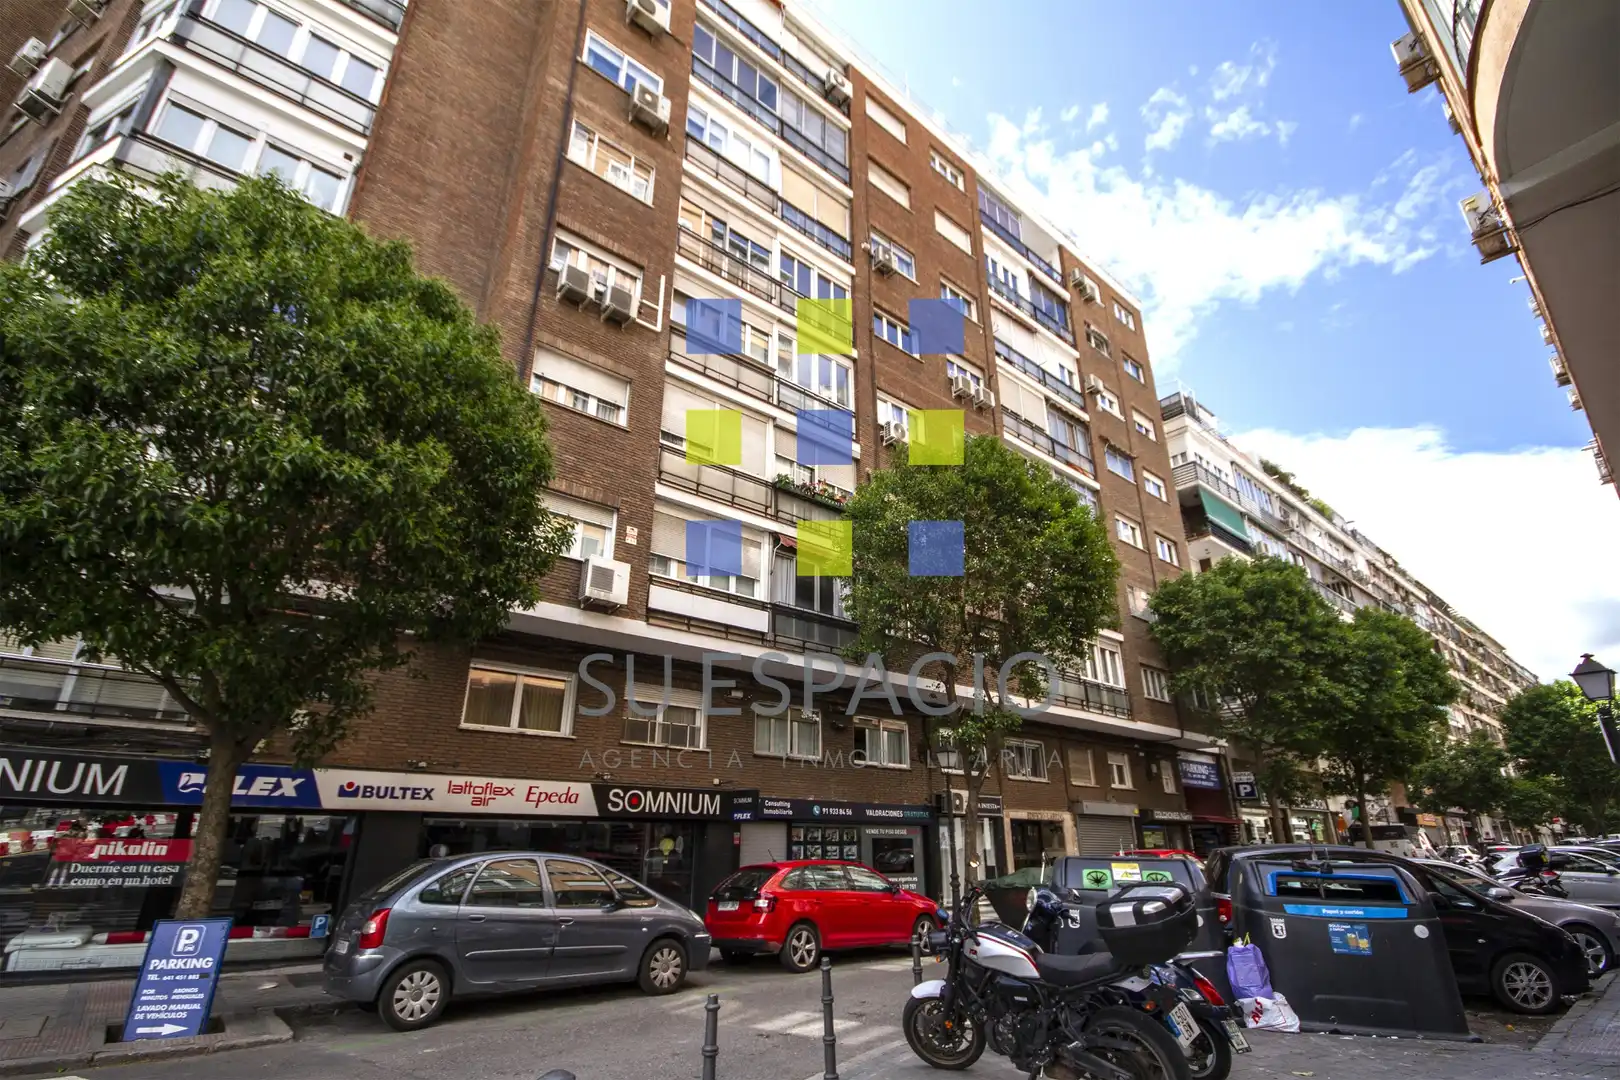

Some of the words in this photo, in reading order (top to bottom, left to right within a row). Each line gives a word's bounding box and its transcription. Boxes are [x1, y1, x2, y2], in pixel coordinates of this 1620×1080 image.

[203, 773, 305, 797] LEX
[448, 780, 516, 797] lattoflex
[1239, 784, 1252, 797] P
[361, 784, 435, 801] BULTEX
[525, 785, 580, 809] Epeda
[471, 796, 497, 807] air
[607, 788, 721, 815] SOMNIUM
[764, 800, 791, 809] Consulting
[866, 808, 904, 818] VALORACIONES
[70, 863, 120, 874] Duerme
[121, 865, 137, 874] en
[138, 863, 151, 873] tu
[152, 865, 180, 873] casa
[70, 876, 105, 886] como
[107, 877, 122, 886] en
[124, 877, 141, 886] un
[142, 875, 173, 885] hotel
[315, 916, 326, 929] P
[176, 929, 199, 952] P
[149, 957, 214, 971] PARKING
[168, 1003, 202, 1011] MANUAL
[134, 1012, 144, 1020] DE
